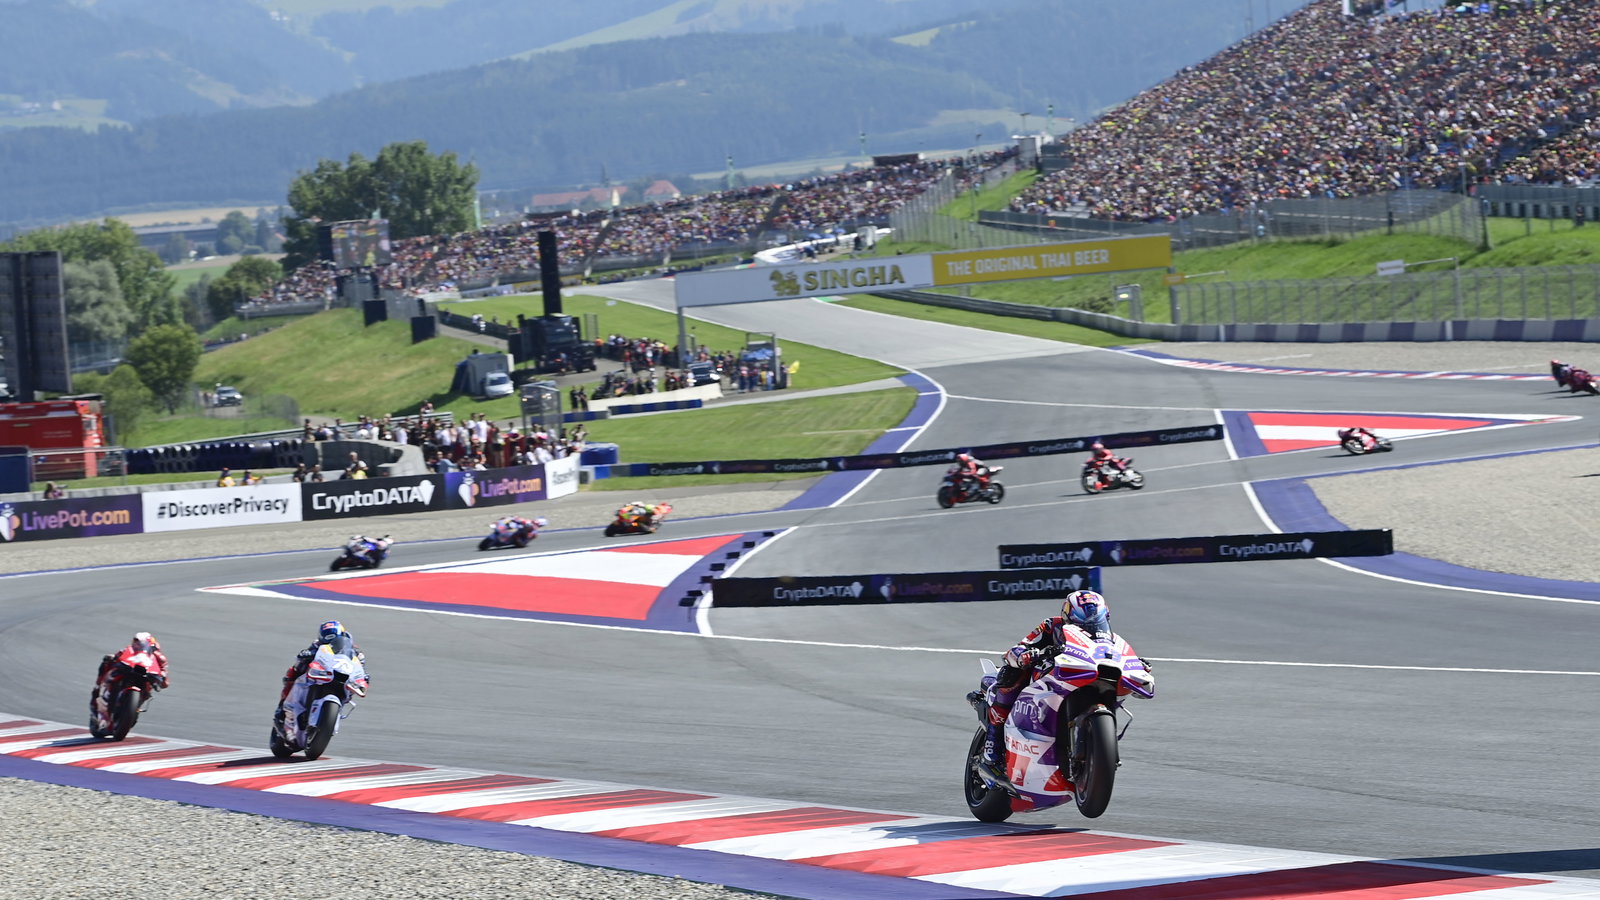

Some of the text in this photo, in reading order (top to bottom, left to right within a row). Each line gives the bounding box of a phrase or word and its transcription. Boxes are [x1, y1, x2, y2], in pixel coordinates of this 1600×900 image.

[946, 249, 1109, 276] THE ORIGINAL THAI BEER
[803, 264, 905, 291] SINGHA
[480, 477, 542, 498] LivePot.com
[157, 497, 289, 519] #DiscoverPrivacy
[312, 485, 423, 513] CryptoDATA
[22, 509, 131, 532] LivePot.com
[1001, 551, 1083, 567] CryptoDATA
[1219, 542, 1303, 557] CryptoDATA
[774, 585, 852, 601] CryptoDATA
[988, 579, 1072, 595] CryptoDATA
